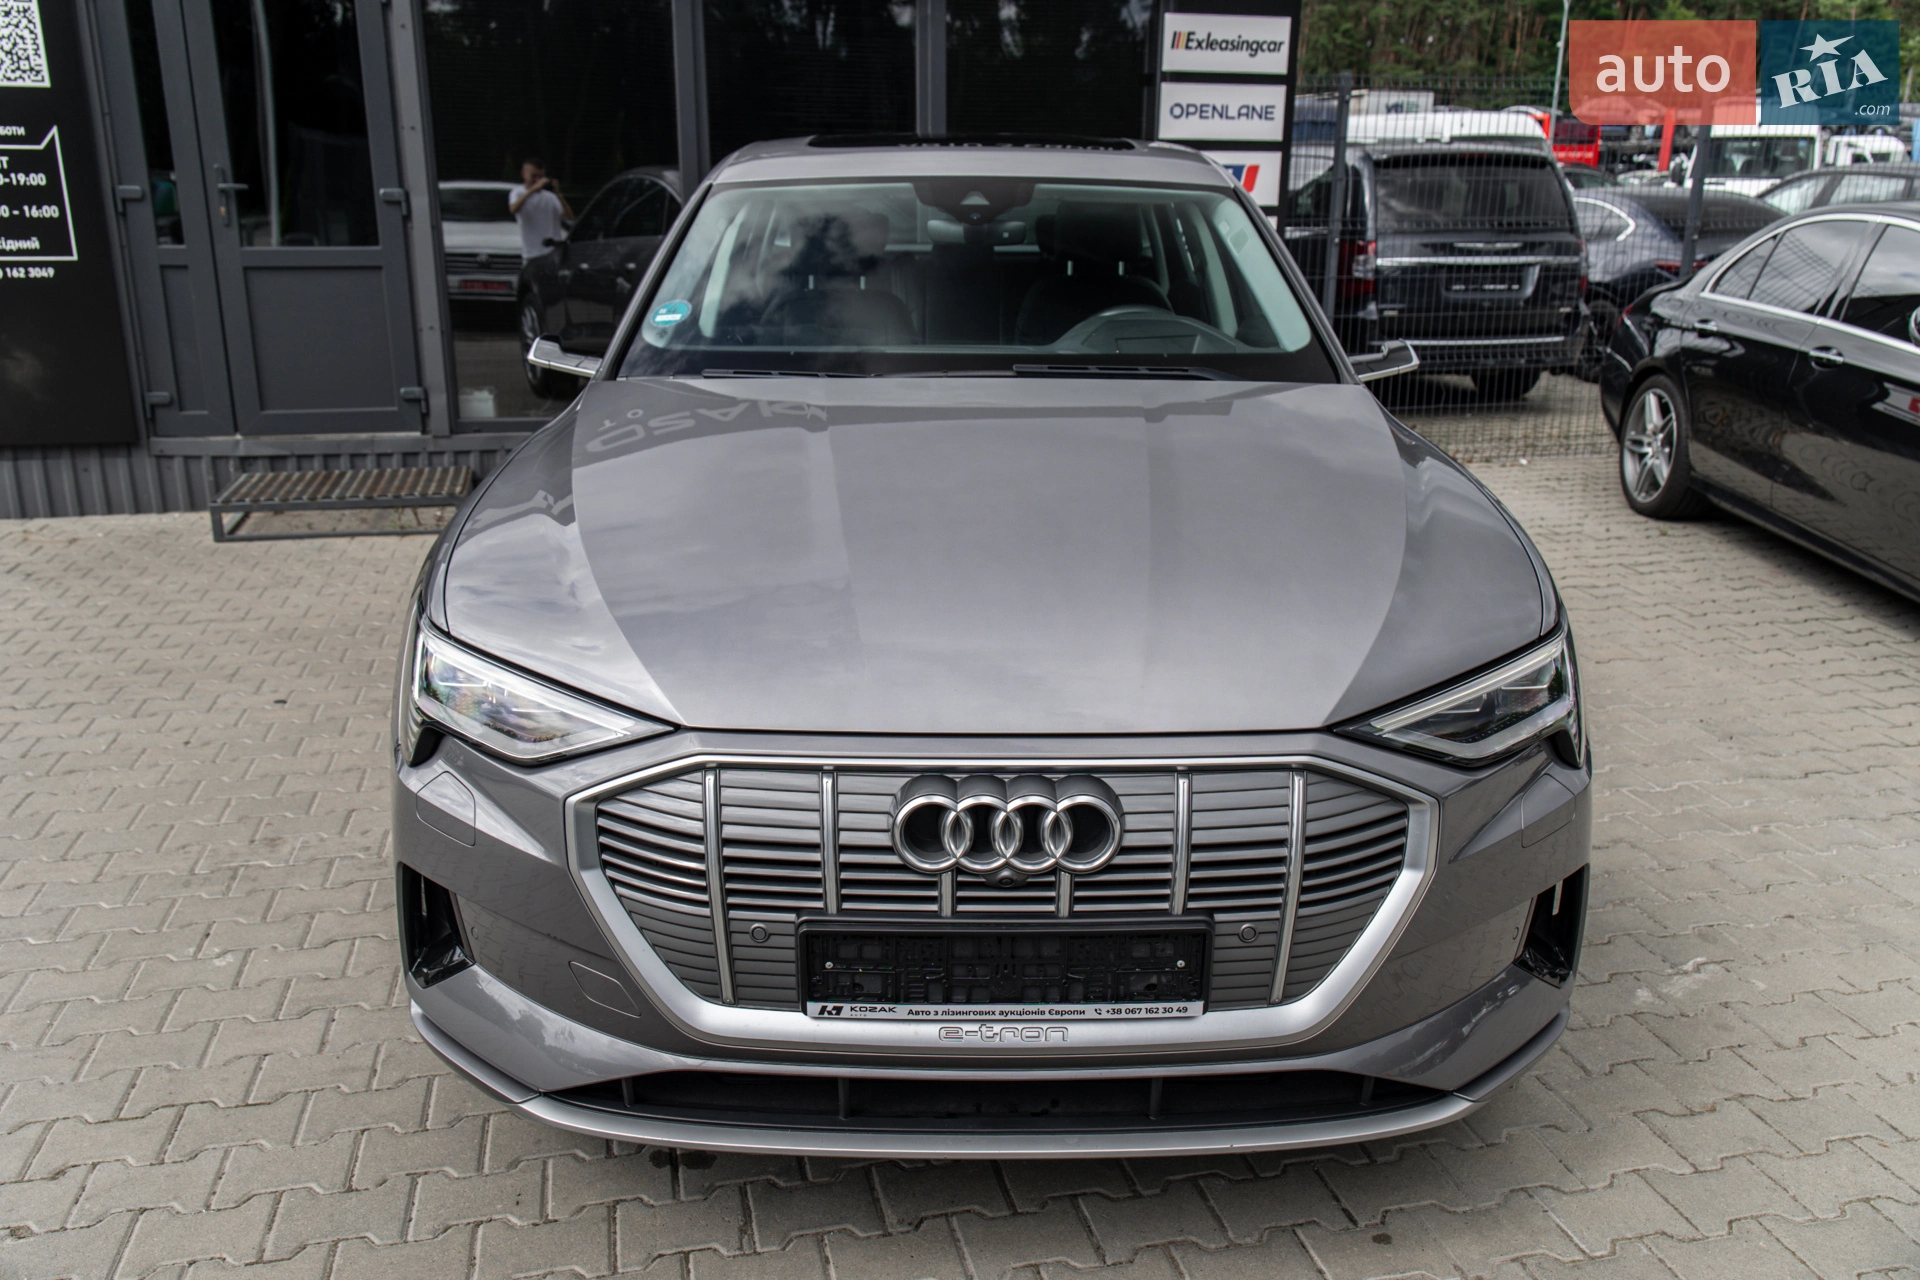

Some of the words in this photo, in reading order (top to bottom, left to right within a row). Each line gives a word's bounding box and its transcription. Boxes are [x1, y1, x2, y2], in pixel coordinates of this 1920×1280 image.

[1184, 31, 1285, 58] Exleasingcar
[1169, 102, 1276, 121] OPENLANE
[23, 204, 60, 218] 16:00
[0, 236, 40, 252] ідний
[5, 266, 26, 279] 162
[27, 266, 55, 279] 3049
[850, 1005, 898, 1014] KOZAK
[907, 1008, 931, 1016] Авто
[940, 1008, 996, 1017] лізингових
[998, 1007, 1046, 1018] аукціонів
[1048, 1007, 1086, 1017] Європи
[1105, 1007, 1123, 1015] +38
[1124, 1007, 1143, 1015] 067
[1144, 1006, 1160, 1014] 162
[1161, 1006, 1174, 1014] 30
[1175, 1005, 1188, 1014] 49
[938, 1023, 1069, 1043] e-tron
